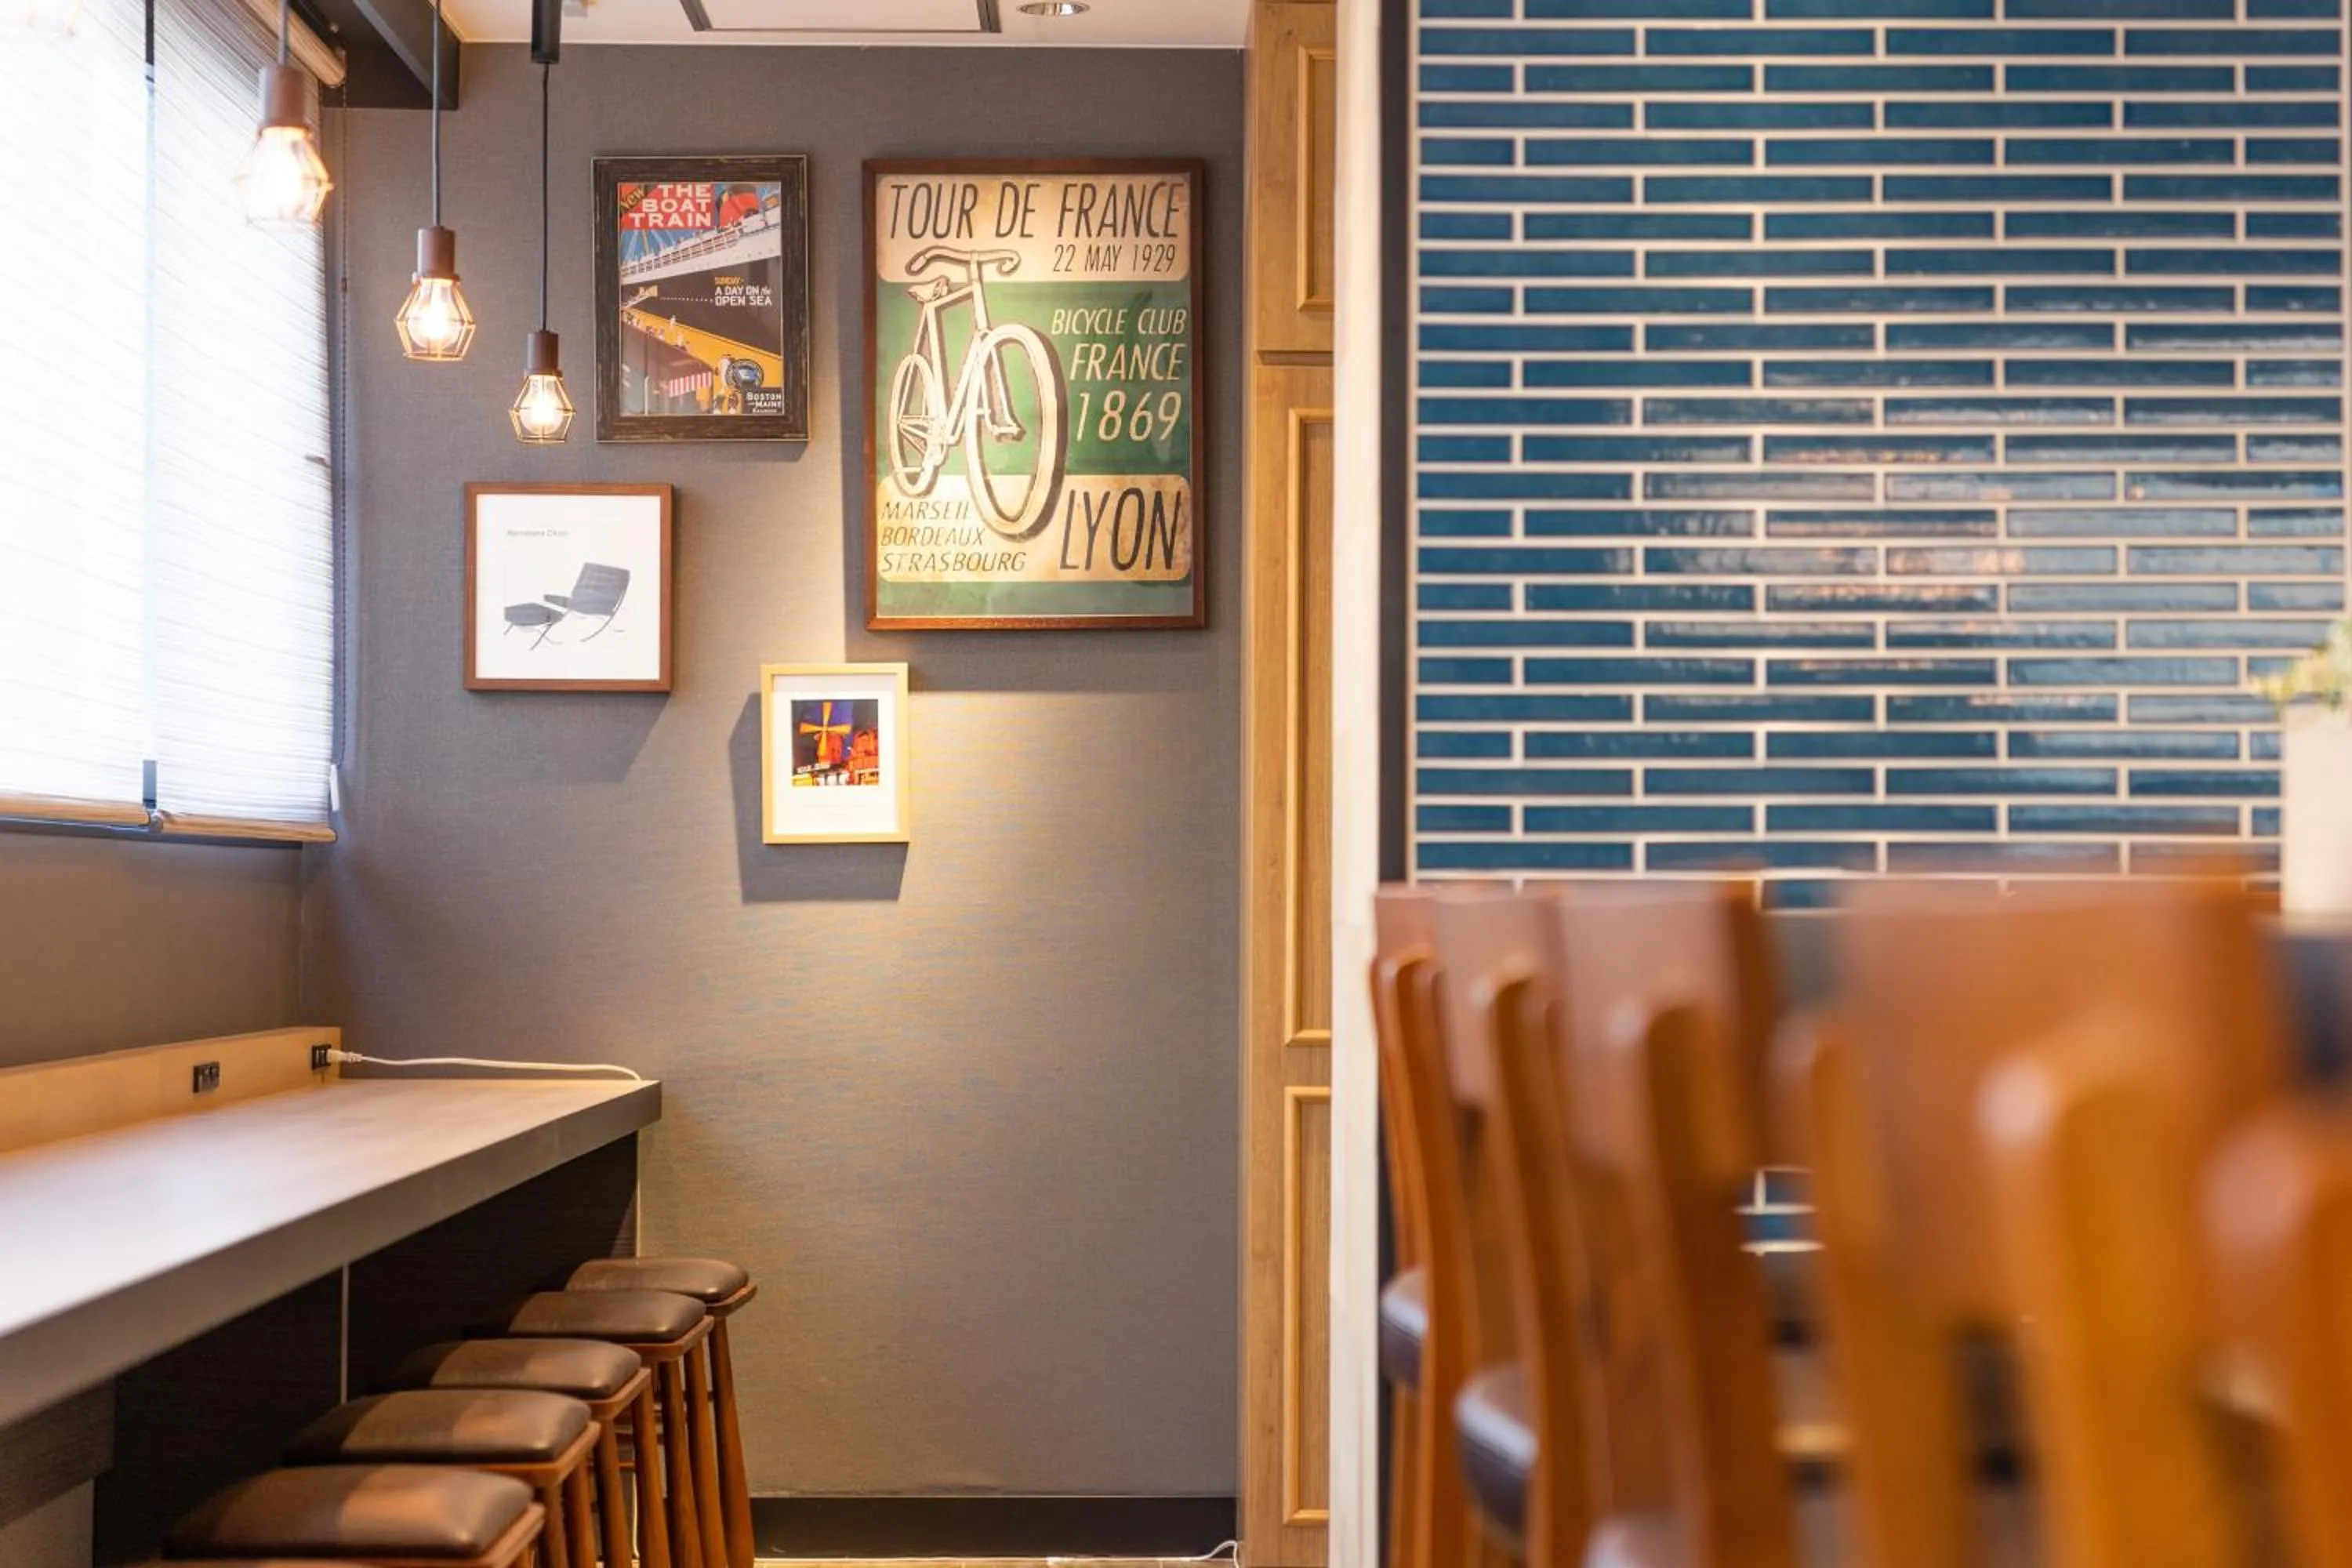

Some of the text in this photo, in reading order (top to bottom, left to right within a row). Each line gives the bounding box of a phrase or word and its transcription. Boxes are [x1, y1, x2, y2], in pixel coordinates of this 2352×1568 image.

[658, 184, 711, 198] THE
[642, 198, 711, 212] BOAT
[890, 181, 1185, 239] TOUR DE FRANCE
[629, 212, 711, 227] TRAIN
[1053, 244, 1176, 273] 22 MAY 1929
[714, 286, 722, 296] A
[724, 285, 744, 296] DAY
[746, 285, 760, 296] ON
[714, 296, 772, 307] OPEN SEA
[1051, 307, 1188, 336] BICYCLE CLUB
[1069, 343, 1188, 381] FRANCE
[746, 392, 782, 401] BOSTON
[1076, 390, 1182, 442] 1869
[880, 526, 985, 547] BORDEAUX
[1060, 487, 1181, 572] LYON
[882, 551, 1027, 572] STRASBOURG
